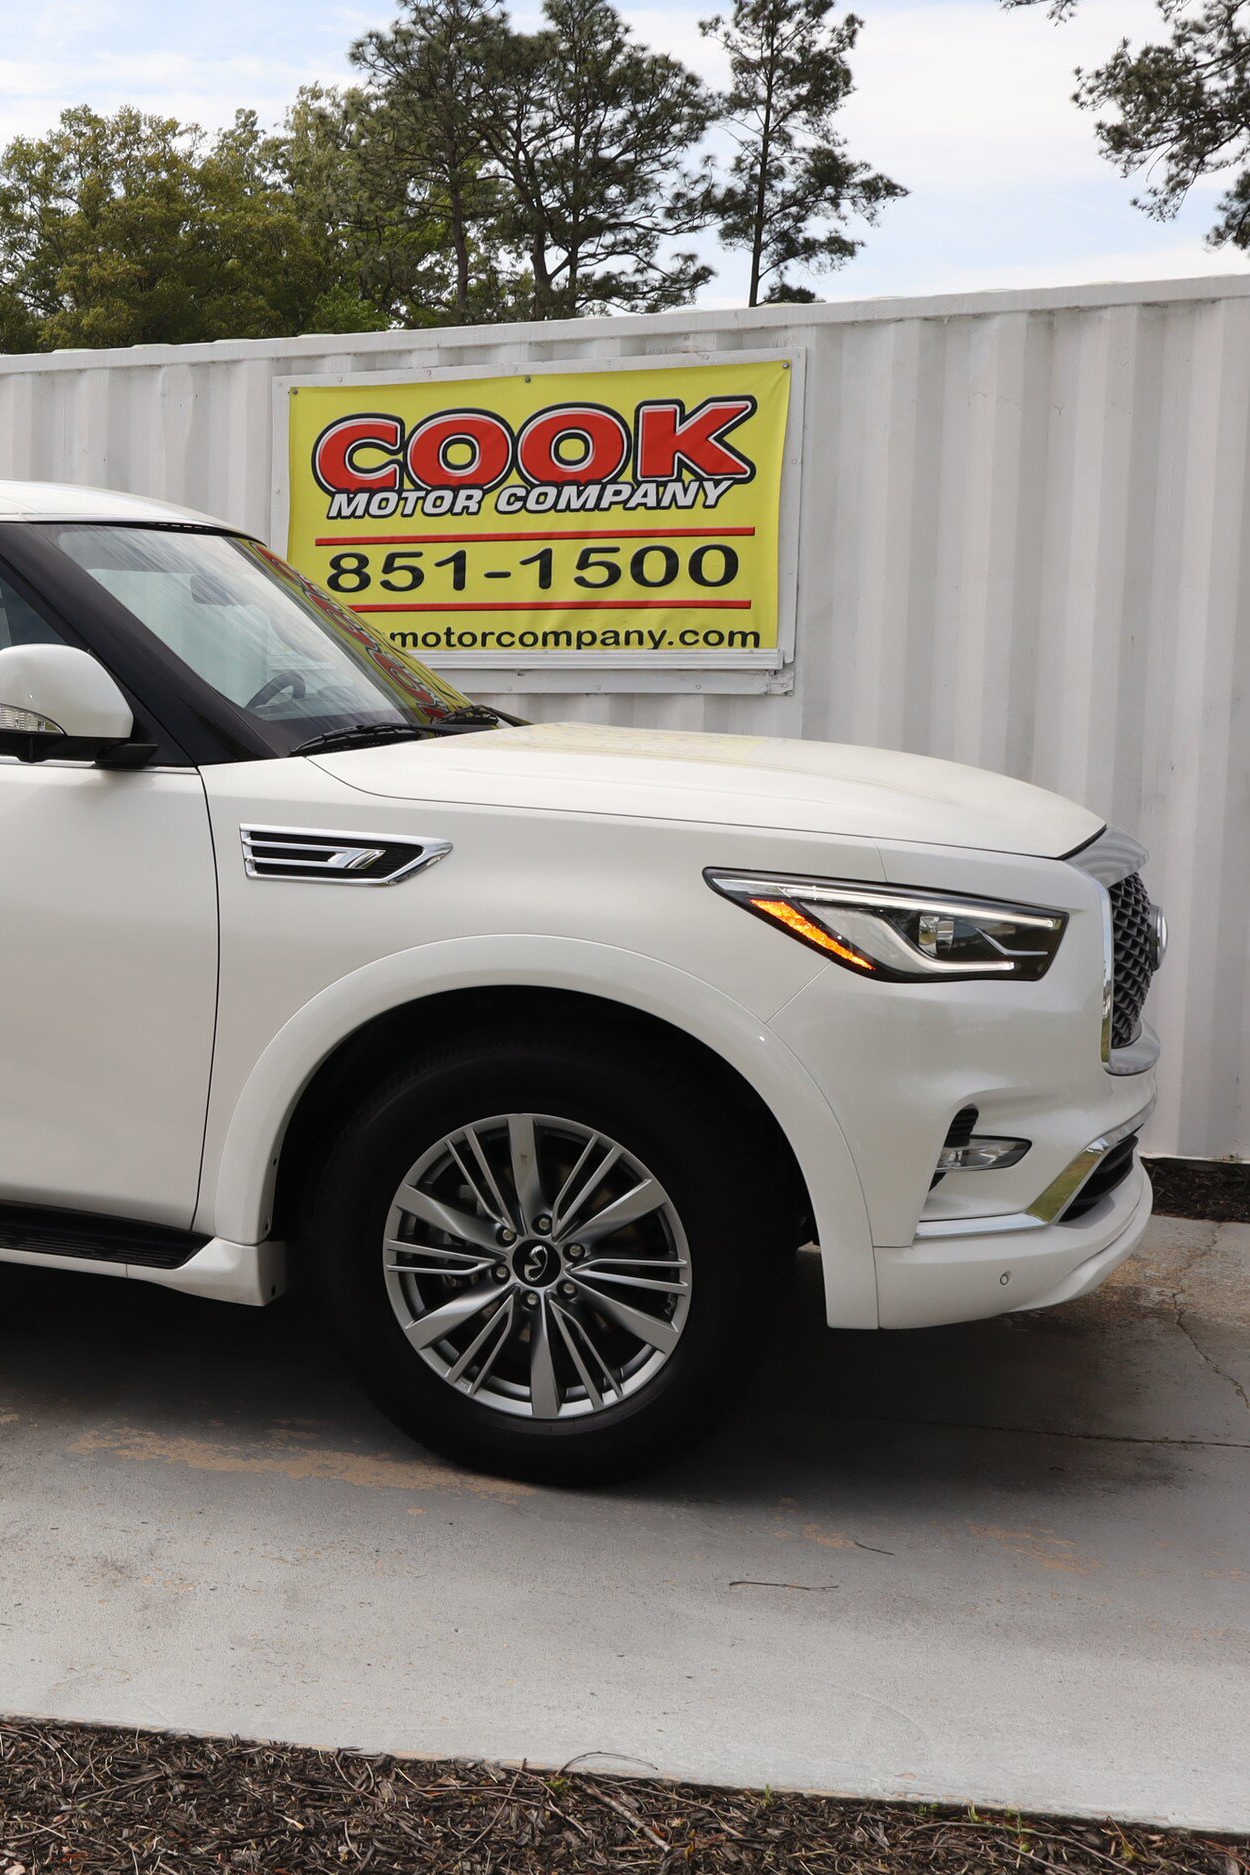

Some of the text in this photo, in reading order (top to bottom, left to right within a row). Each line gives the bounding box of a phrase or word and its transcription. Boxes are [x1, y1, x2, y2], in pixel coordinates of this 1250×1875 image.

[312, 396, 757, 496] COOK
[327, 479, 734, 519] MOTOR COMPANY
[326, 544, 739, 593] 851-1500
[388, 626, 760, 650] motorcompany.com
